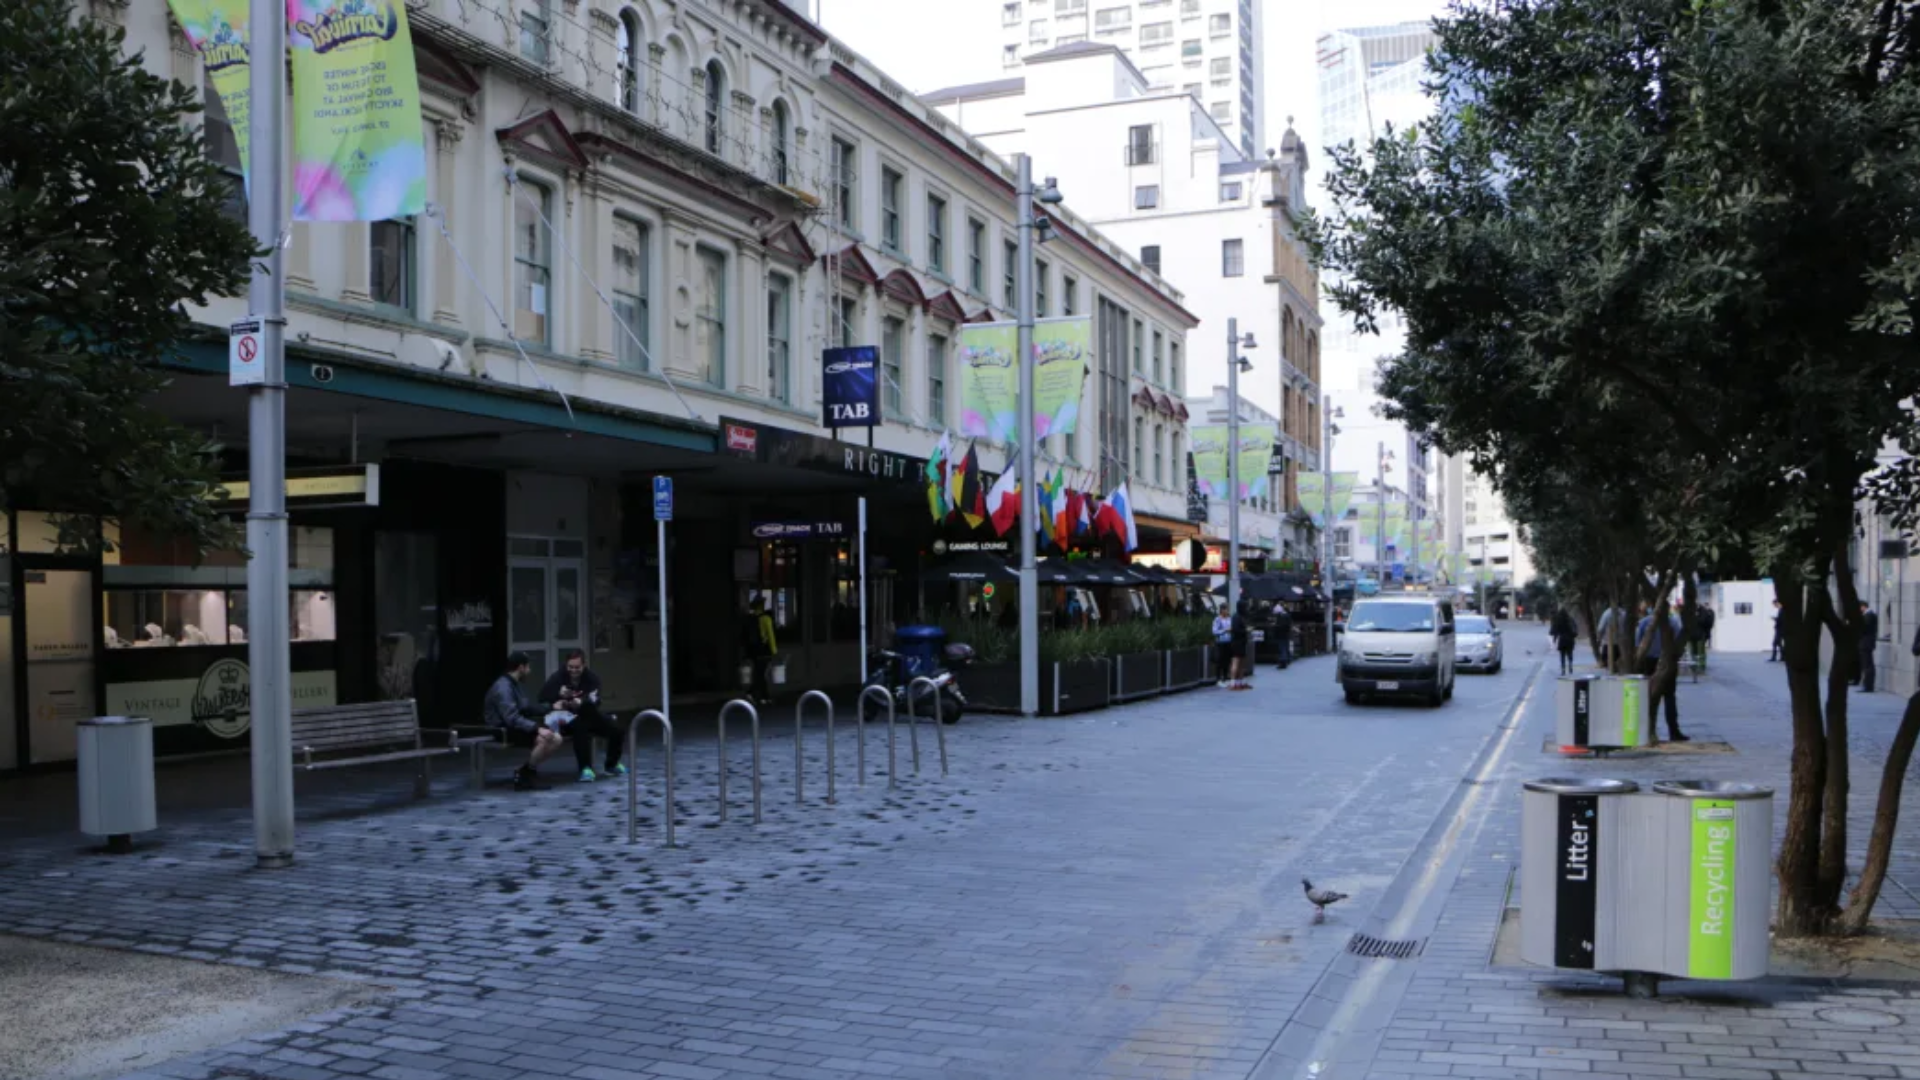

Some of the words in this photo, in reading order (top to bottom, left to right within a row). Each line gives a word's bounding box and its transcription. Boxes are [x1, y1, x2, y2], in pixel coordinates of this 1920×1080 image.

[829, 401, 870, 420] TAB
[844, 448, 907, 479] RIGHT
[815, 522, 843, 534] TAB
[293, 685, 329, 700] ELLERY
[1577, 689, 1587, 713] Litter
[124, 697, 181, 712] VINTAGE
[1565, 821, 1590, 881] Litter
[1701, 826, 1730, 936] Recycling
